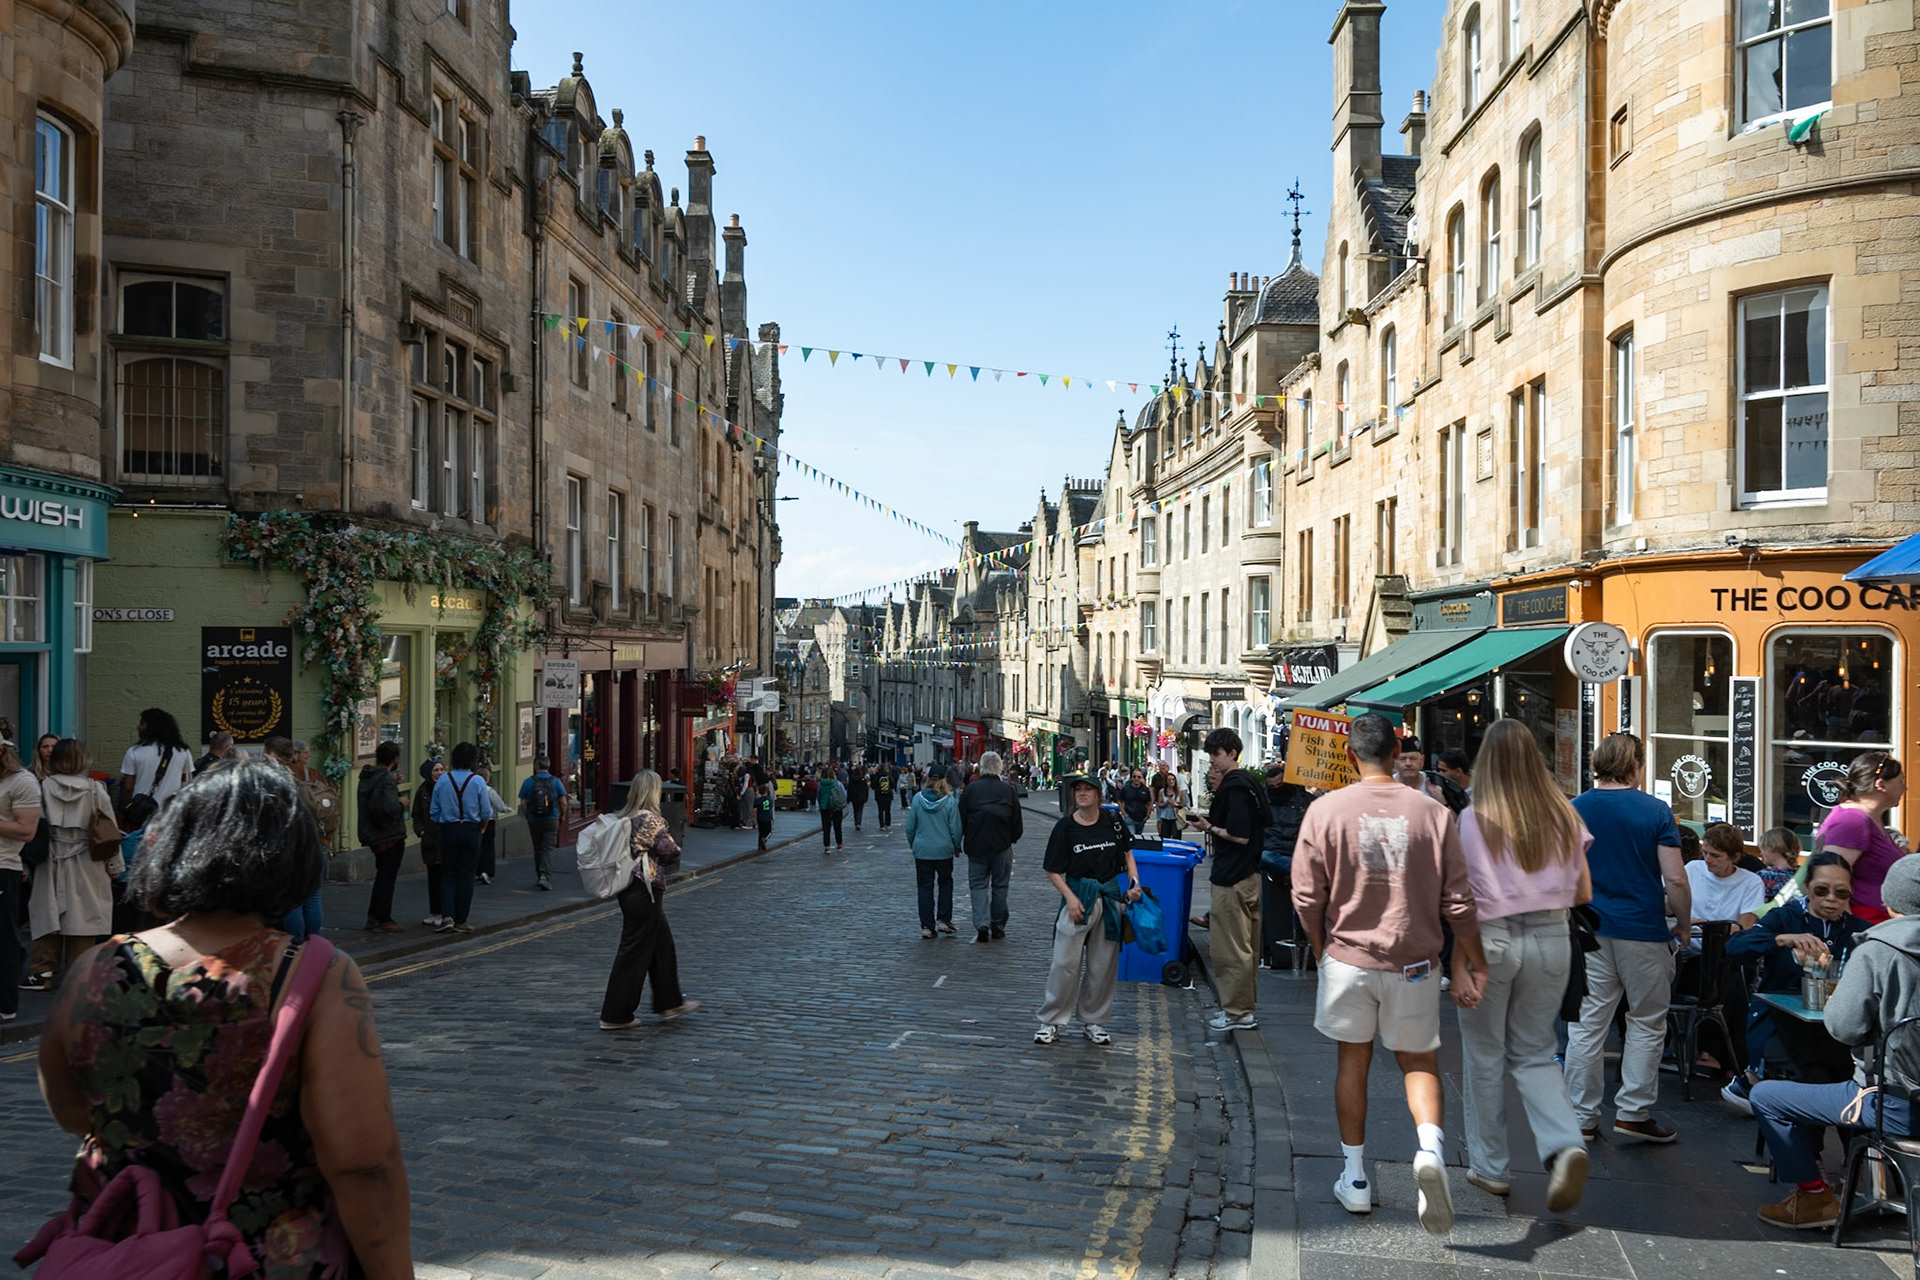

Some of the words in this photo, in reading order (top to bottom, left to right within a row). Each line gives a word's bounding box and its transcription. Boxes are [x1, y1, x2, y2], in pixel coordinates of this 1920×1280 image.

[1, 495, 83, 529] WISH
[1517, 600, 1529, 615] THE
[1531, 599, 1545, 614] COO
[1546, 595, 1564, 612] CAFE
[1711, 588, 1767, 611] THE
[1776, 586, 1851, 611] COO
[126, 609, 170, 620] CLOSE
[207, 640, 288, 658] arcade
[1582, 664, 1597, 677] COO
[1599, 665, 1618, 678] CAFE
[1298, 714, 1330, 731] YUM
[1300, 732, 1325, 747] Fish
[1329, 738, 1337, 749] &
[1296, 765, 1335, 782] Falafel
[1316, 757, 1353, 774] Pizzas
[1801, 765, 1817, 779] THE
[1817, 761, 1838, 769] COO
[762, 800, 770, 811] 2
[1073, 841, 1116, 853] Champion
